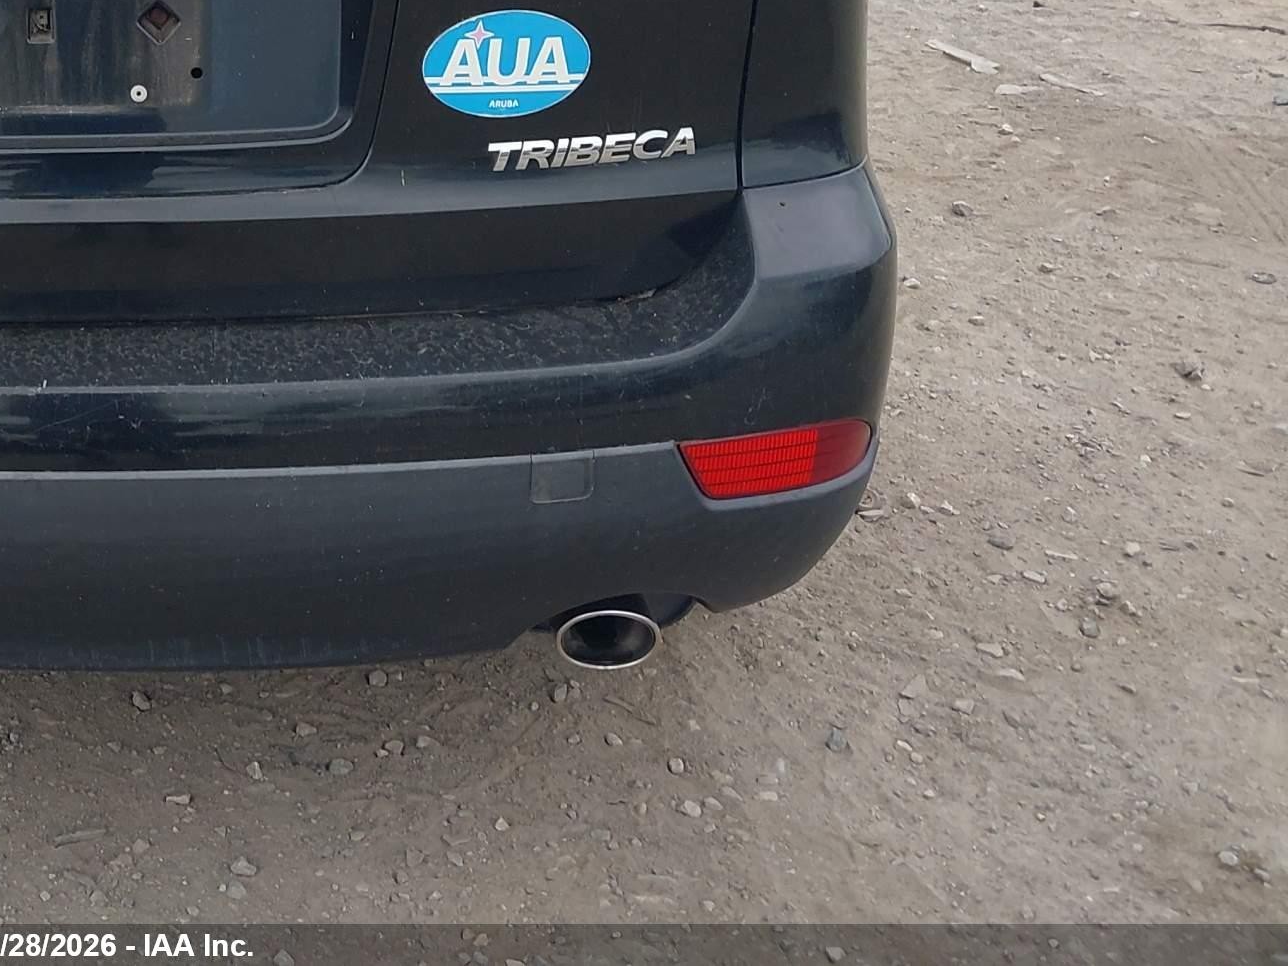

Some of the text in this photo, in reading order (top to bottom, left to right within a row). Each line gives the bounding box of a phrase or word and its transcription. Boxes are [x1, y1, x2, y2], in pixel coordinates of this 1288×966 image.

[440, 36, 570, 86] AUA
[488, 99, 519, 109] ARUBA
[487, 127, 697, 172] TRIBECA
